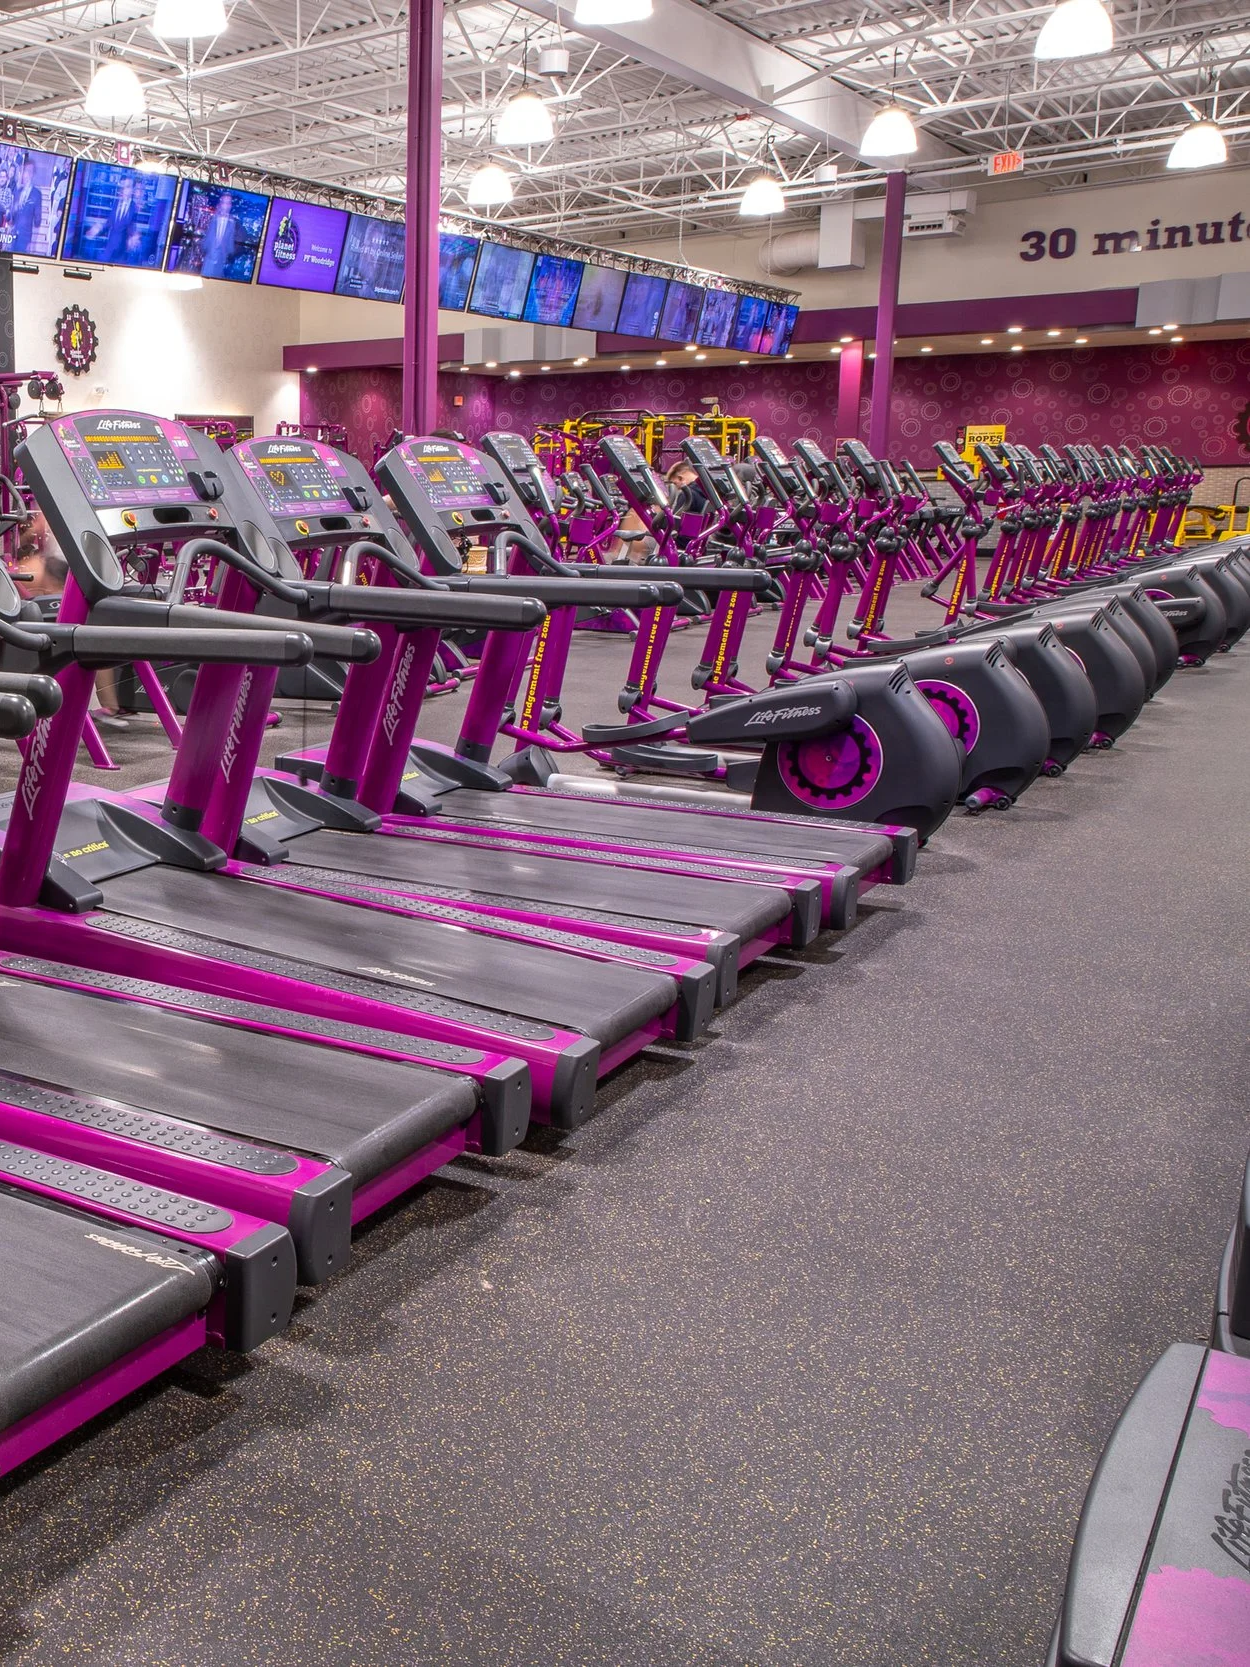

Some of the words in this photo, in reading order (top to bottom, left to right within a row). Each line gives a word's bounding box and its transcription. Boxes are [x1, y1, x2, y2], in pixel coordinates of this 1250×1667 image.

[7, 124, 14, 137] 3
[120, 148, 128, 160] 2
[994, 152, 1017, 174] EXIT
[1020, 228, 1076, 262] 30
[1092, 212, 1250, 255] minut
[274, 241, 295, 254] planet
[311, 244, 328, 253] Welcome
[275, 248, 296, 261] fitness
[968, 434, 1003, 444] ROPES
[723, 608, 733, 633] free
[524, 659, 541, 720] judgement
[535, 640, 546, 658] free
[541, 614, 551, 639] zone
[258, 810, 279, 822] critics
[70, 848, 82, 858] no
[82, 840, 110, 854] critics
